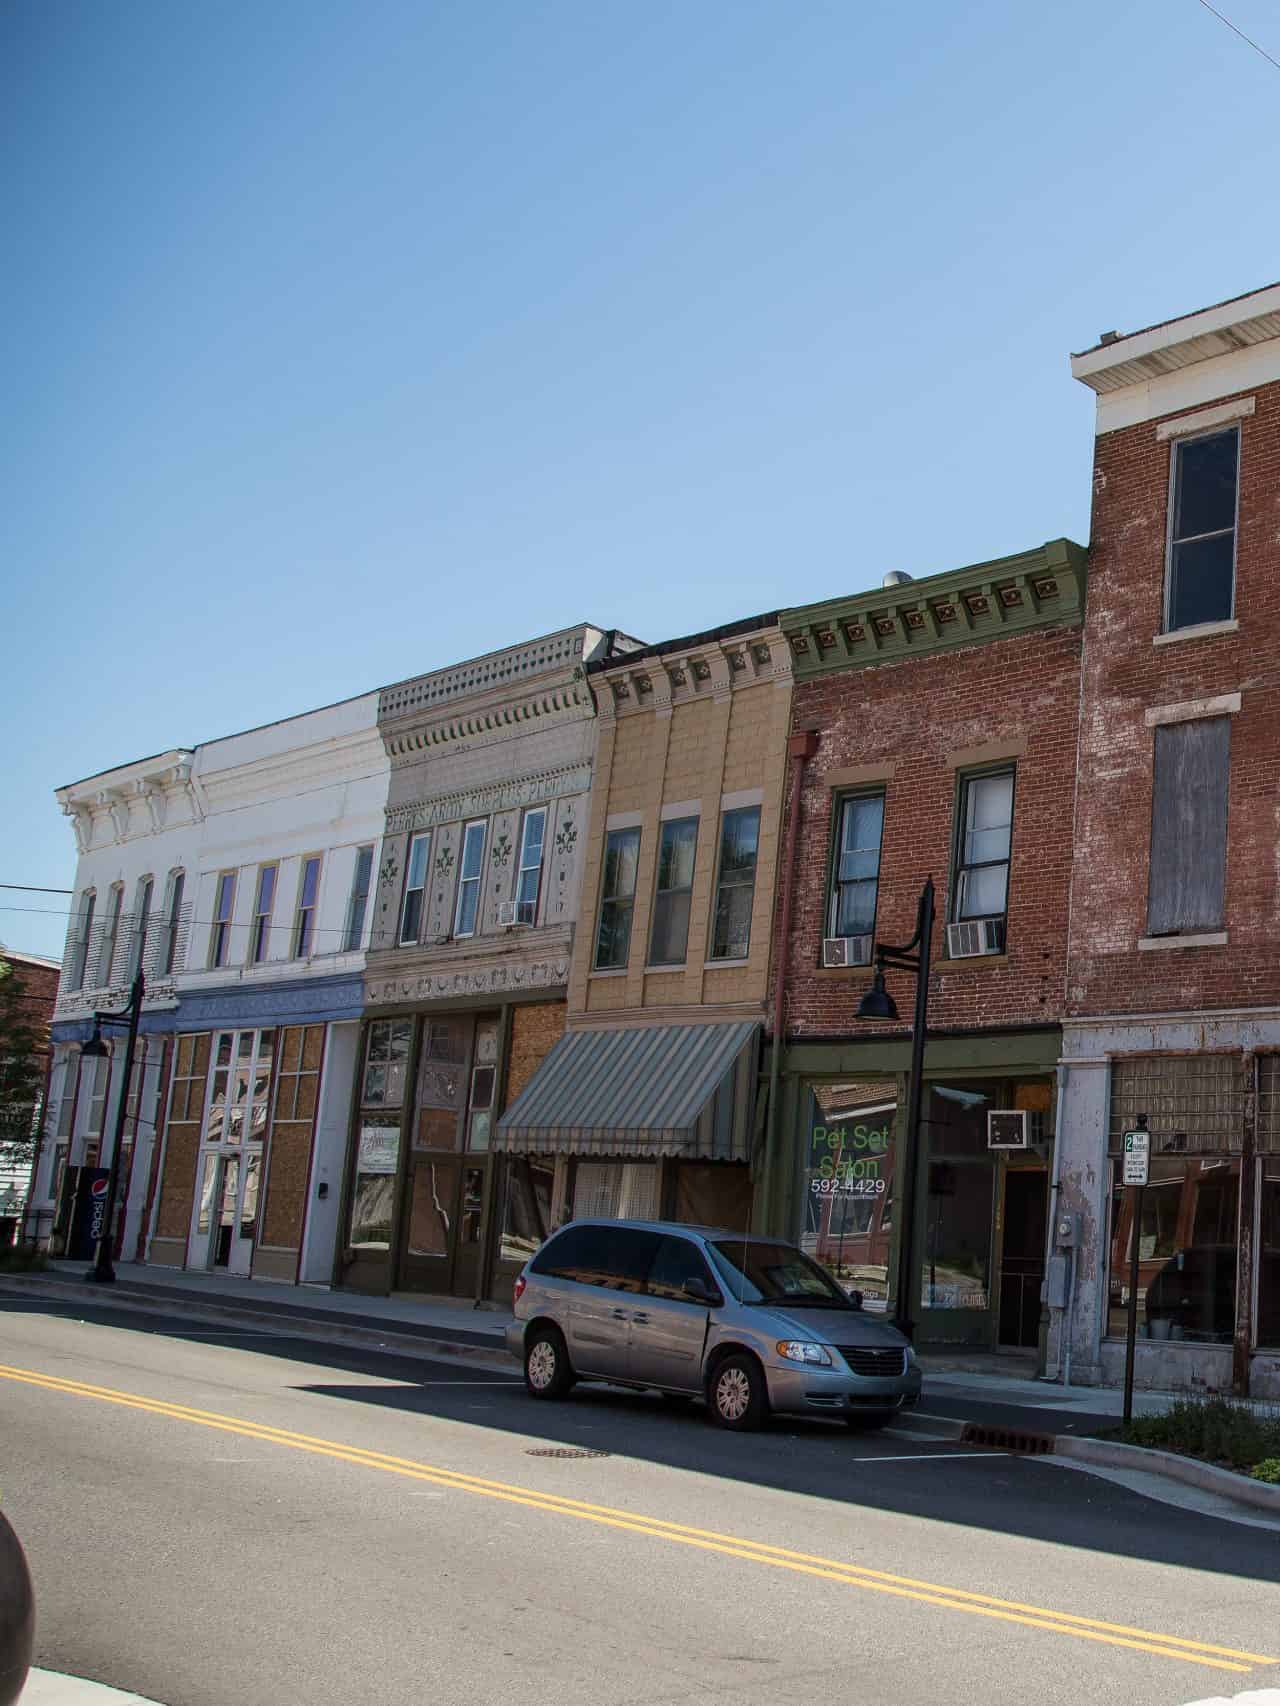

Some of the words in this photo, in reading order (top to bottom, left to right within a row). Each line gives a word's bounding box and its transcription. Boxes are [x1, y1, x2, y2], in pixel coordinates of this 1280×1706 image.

[813, 1126, 847, 1151] Pet
[854, 1125, 889, 1150] Set
[1127, 1136, 1133, 1151] 2
[820, 1153, 879, 1179] Salon
[811, 1179, 886, 1193] 592-4429
[90, 1201, 105, 1239] pepsi
